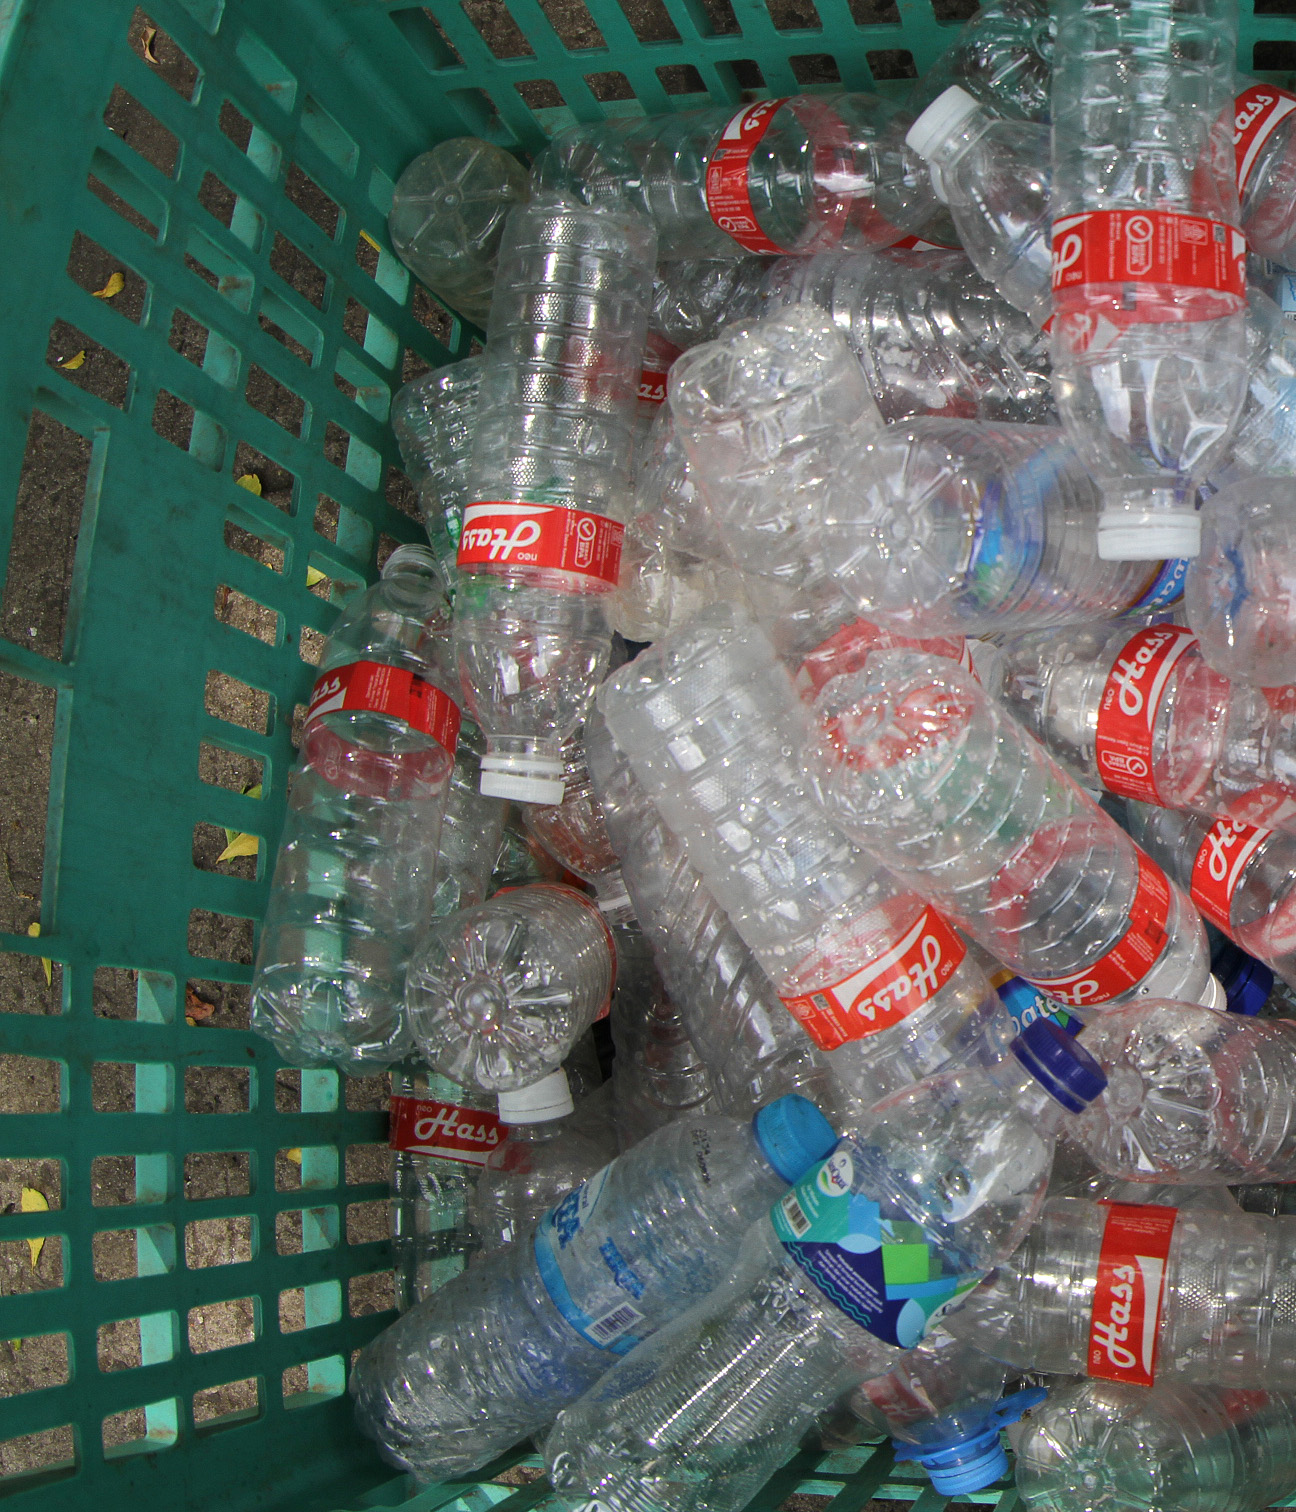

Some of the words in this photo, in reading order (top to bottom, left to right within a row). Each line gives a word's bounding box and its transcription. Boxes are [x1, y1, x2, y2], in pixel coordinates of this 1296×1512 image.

[1232, 93, 1275, 145] ass
[463, 518, 541, 562] Hass
[1111, 629, 1174, 717] Hass
[859, 933, 941, 1019] Hass
[414, 1107, 498, 1145] Hass
[1093, 1265, 1136, 1369] Hass
